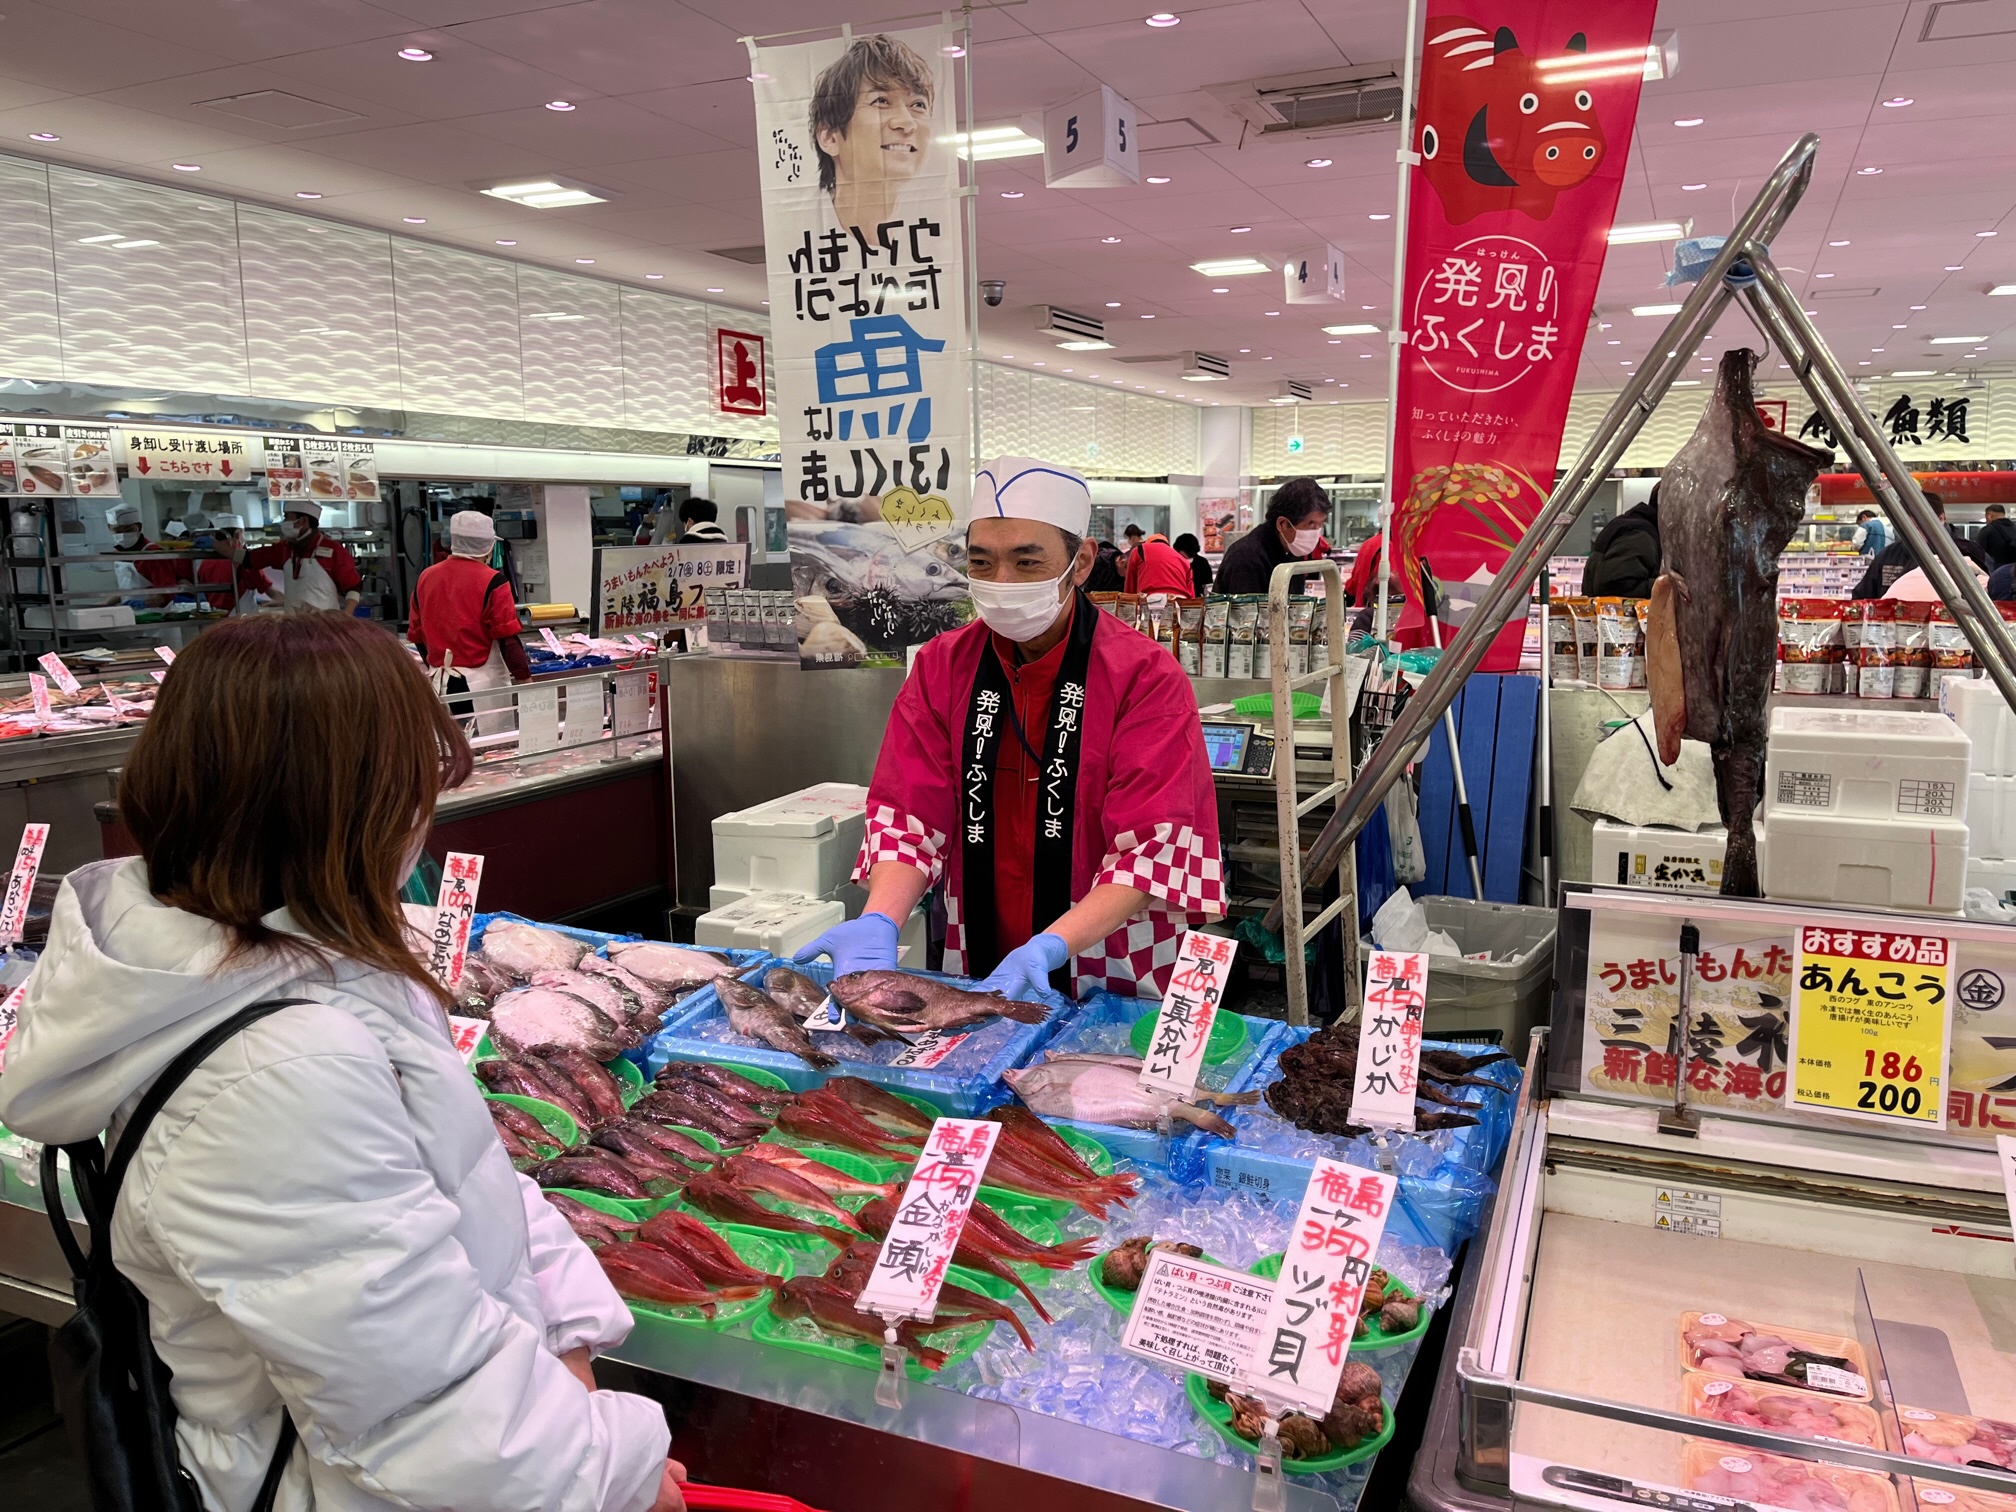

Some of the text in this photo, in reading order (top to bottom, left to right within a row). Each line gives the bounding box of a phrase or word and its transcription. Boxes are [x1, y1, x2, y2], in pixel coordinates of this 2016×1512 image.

[1066, 115, 1079, 154] 5
[1118, 117, 1128, 154] 5
[1298, 260, 1308, 284] 4
[1476, 247, 1521, 261] はっけん
[1433, 256, 1555, 313] 発見!
[1411, 314, 1559, 361] ふくしま
[724, 339, 763, 408] 上
[1455, 366, 1500, 377] FUKUSHIMA
[1411, 406, 1520, 428] 知っていただきたい、
[131, 436, 243, 455] 身卸し受け渡し場所
[1421, 428, 1502, 446] ふくしまの魅力。
[160, 460, 213, 475] こちらです
[603, 548, 681, 593] うまいもんたべよう！
[1923, 806, 1944, 814] 40入
[1924, 790, 1946, 798] 20入
[1924, 798, 1945, 807] 30入
[447, 855, 479, 882] 福島
[1188, 933, 1231, 967] 福島
[1803, 927, 1946, 966] おすすめ品
[1171, 968, 1220, 1005] 400円
[1370, 953, 1422, 985] 福島
[1799, 962, 1946, 1006] あんこう
[1367, 989, 1425, 1021] 450円
[1828, 994, 1914, 1011] 西のフグ 東のアンコウ
[1828, 1014, 1912, 1030] 唐揚げが美味しいです
[1149, 992, 1201, 1080] 真かれい
[1860, 1027, 1879, 1037] 100g
[1360, 1014, 1401, 1096] かじか
[1798, 1048, 1940, 1087] 本体価格 186 円
[1796, 1080, 1938, 1119] 税込価格 200 円
[934, 1121, 991, 1160] 福島
[911, 1162, 977, 1206] 450円
[1311, 1164, 1385, 1219] 福島
[878, 1190, 941, 1284] 金頭
[917, 1199, 953, 1276] かながしら
[1300, 1219, 1371, 1287] 350円
[1267, 1264, 1329, 1385] ツブ貝
[1317, 1279, 1364, 1367] 刺身
[1138, 1338, 1248, 1379] 美味しく召し上がって頂けま
